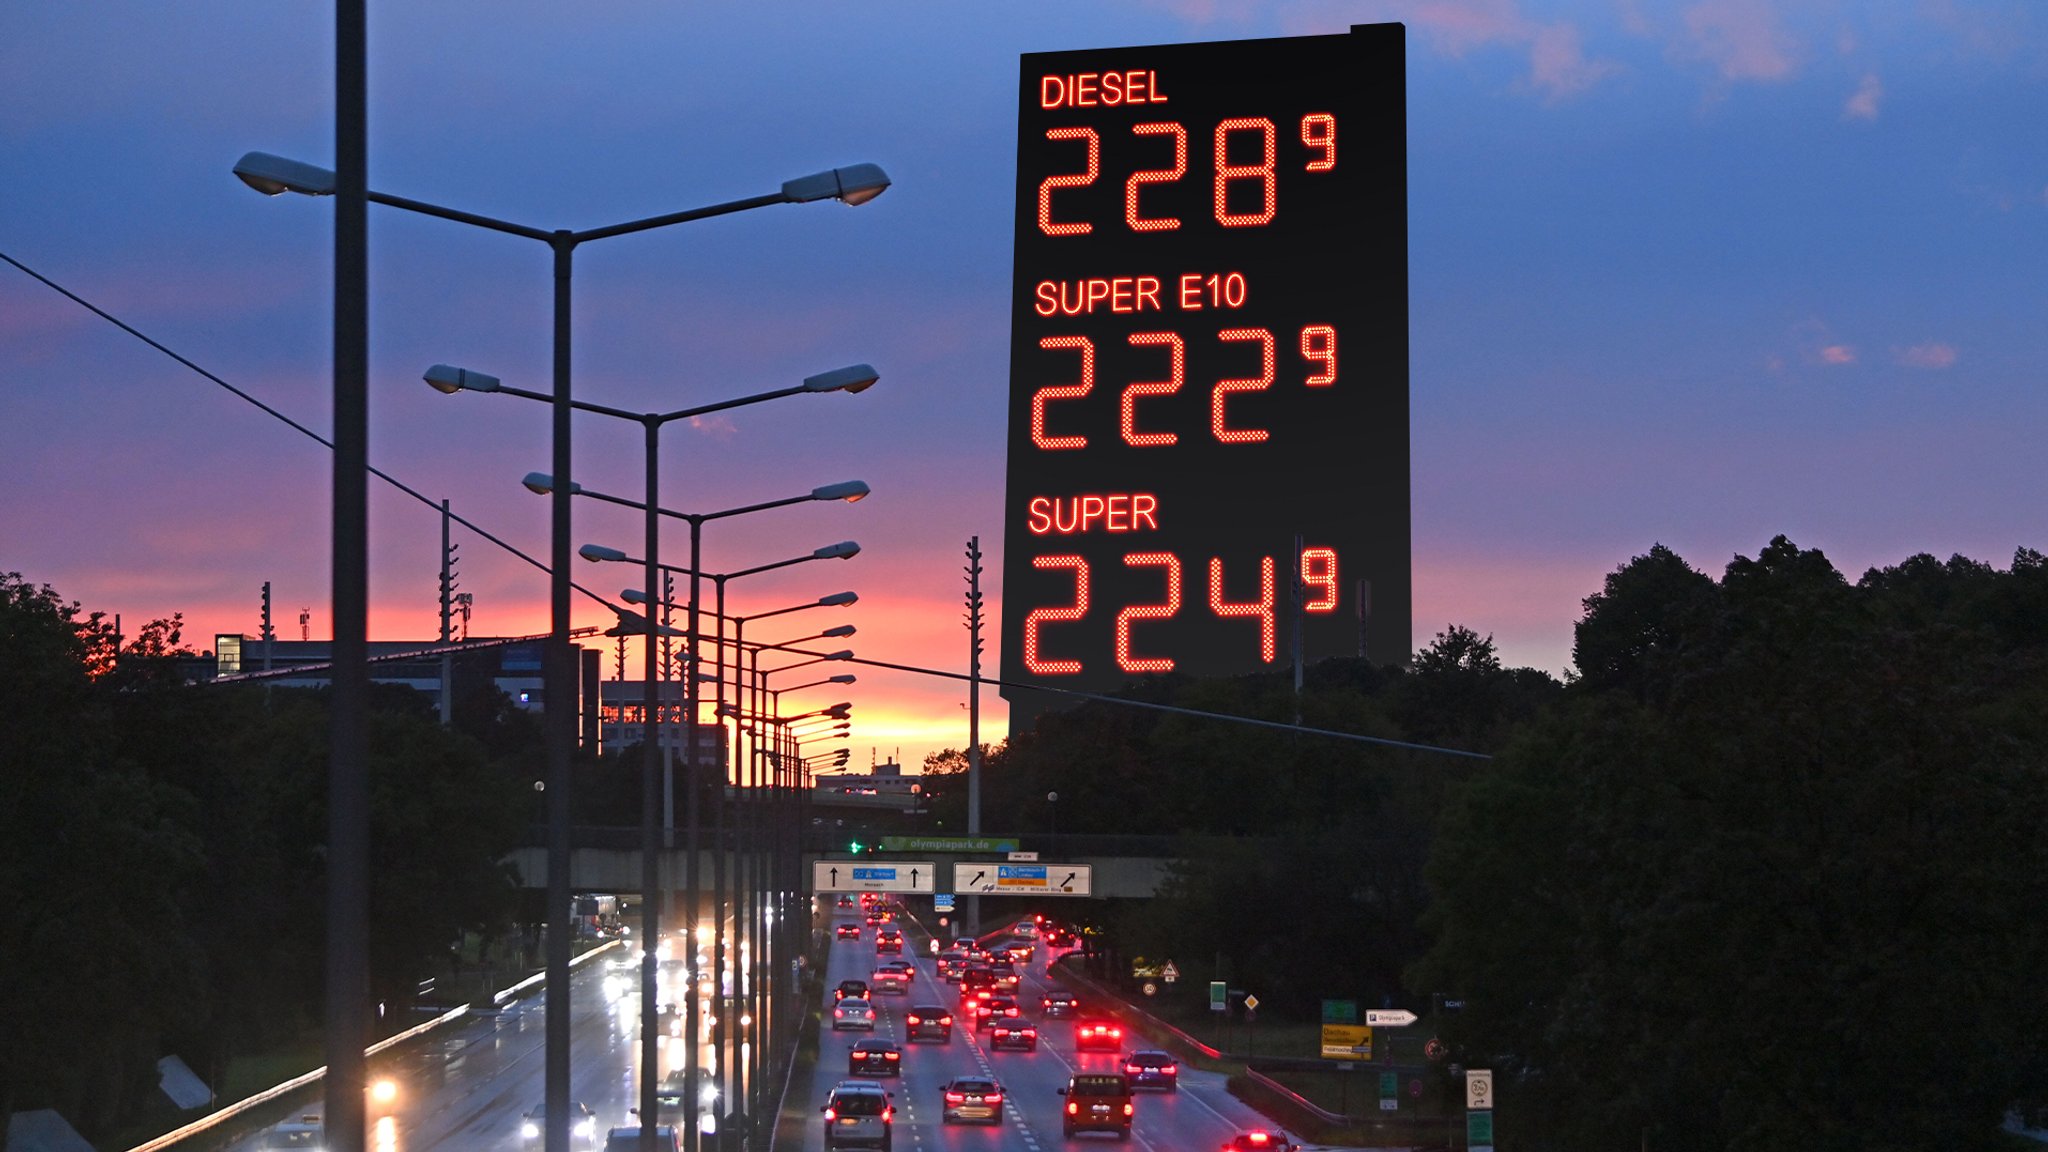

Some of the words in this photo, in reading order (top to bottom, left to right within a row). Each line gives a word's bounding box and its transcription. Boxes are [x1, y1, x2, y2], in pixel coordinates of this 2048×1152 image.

[1041, 70, 1168, 108] DIESEL
[1035, 275, 1161, 317] SUPER
[1180, 272, 1247, 309] E10
[1028, 493, 1157, 535] SUPER
[910, 838, 989, 851] olympiapark.de
